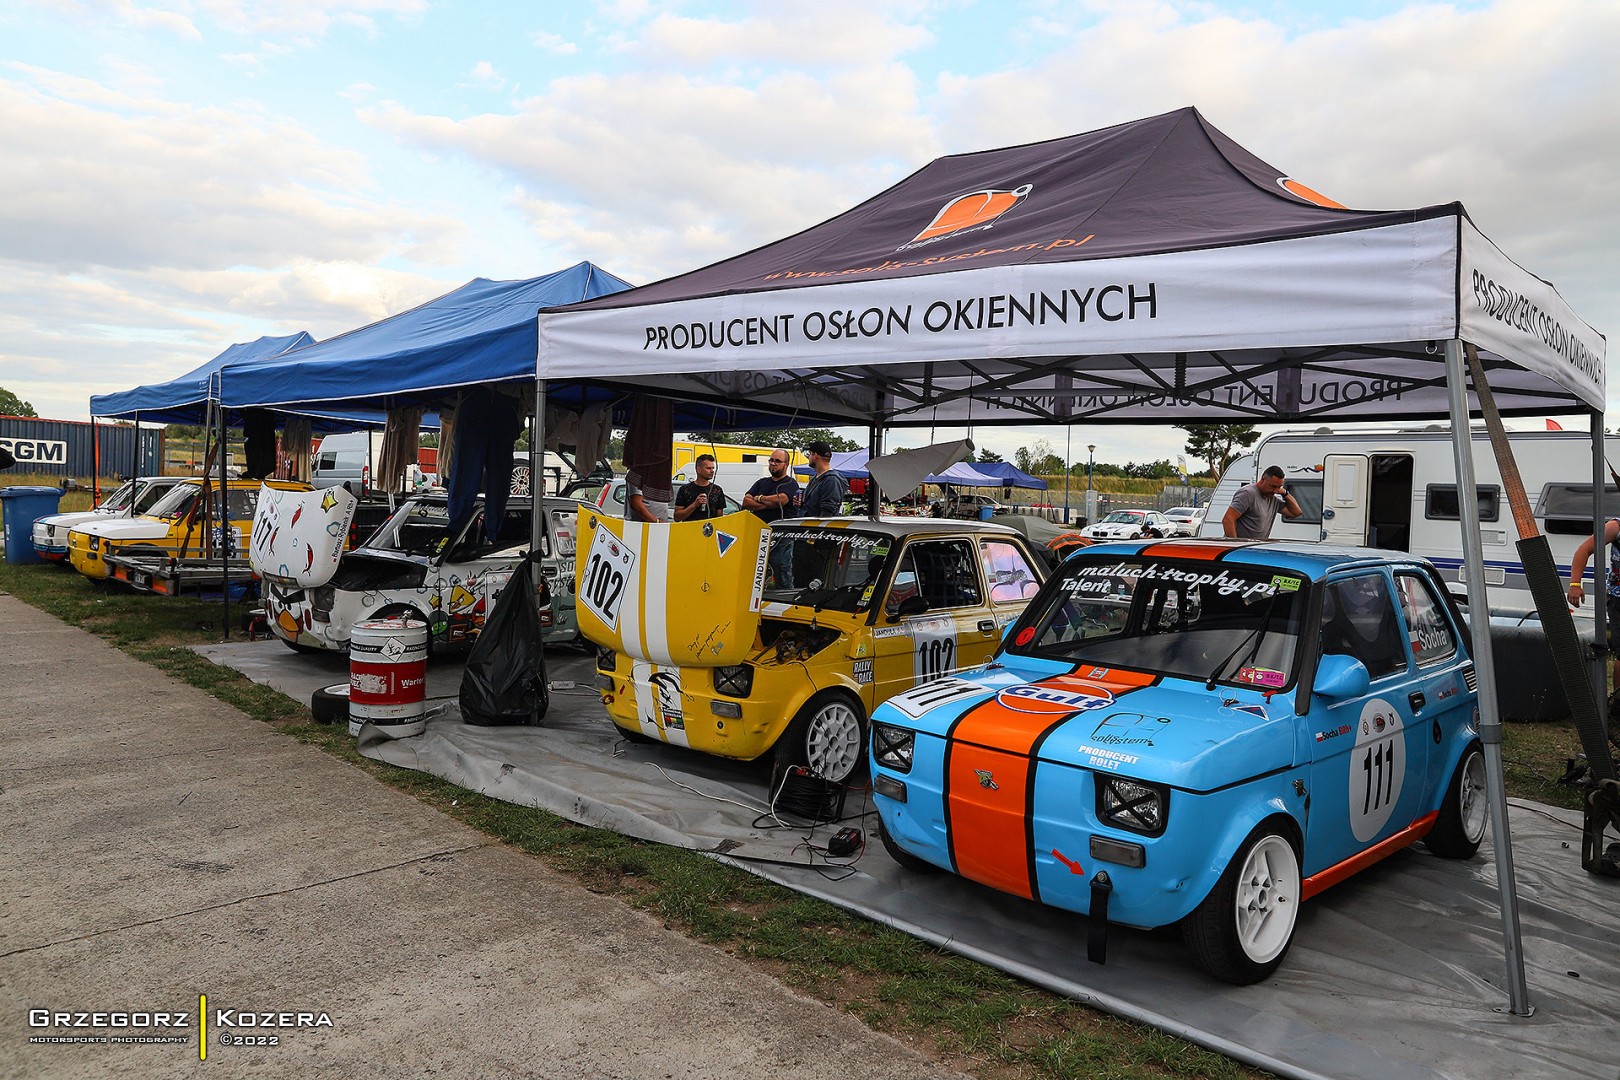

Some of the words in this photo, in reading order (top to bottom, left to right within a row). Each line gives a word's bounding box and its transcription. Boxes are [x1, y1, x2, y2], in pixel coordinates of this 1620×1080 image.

[643, 314, 795, 351] PRODUCENT
[802, 305, 912, 341] OSŁON
[922, 283, 1157, 334] OKIENNYCH
[1472, 268, 1540, 338] PRODUCENT
[1538, 311, 1569, 358] OSŁON
[1569, 334, 1602, 386] OKIENNYCH
[253, 510, 272, 551] 117
[761, 532, 770, 545] M.
[756, 545, 767, 592] JANDUŁA
[586, 553, 623, 620] 102
[1060, 578, 1111, 594] Talent
[1418, 627, 1447, 651] Socha
[854, 660, 872, 673] RALLY
[919, 637, 955, 685] 102
[859, 671, 873, 684] RACE
[1005, 686, 1110, 710] Gulf
[1322, 729, 1338, 741] Socha
[1078, 745, 1140, 765] PRODUCENT
[1088, 756, 1122, 770] ROLET
[1363, 739, 1394, 816] 111
